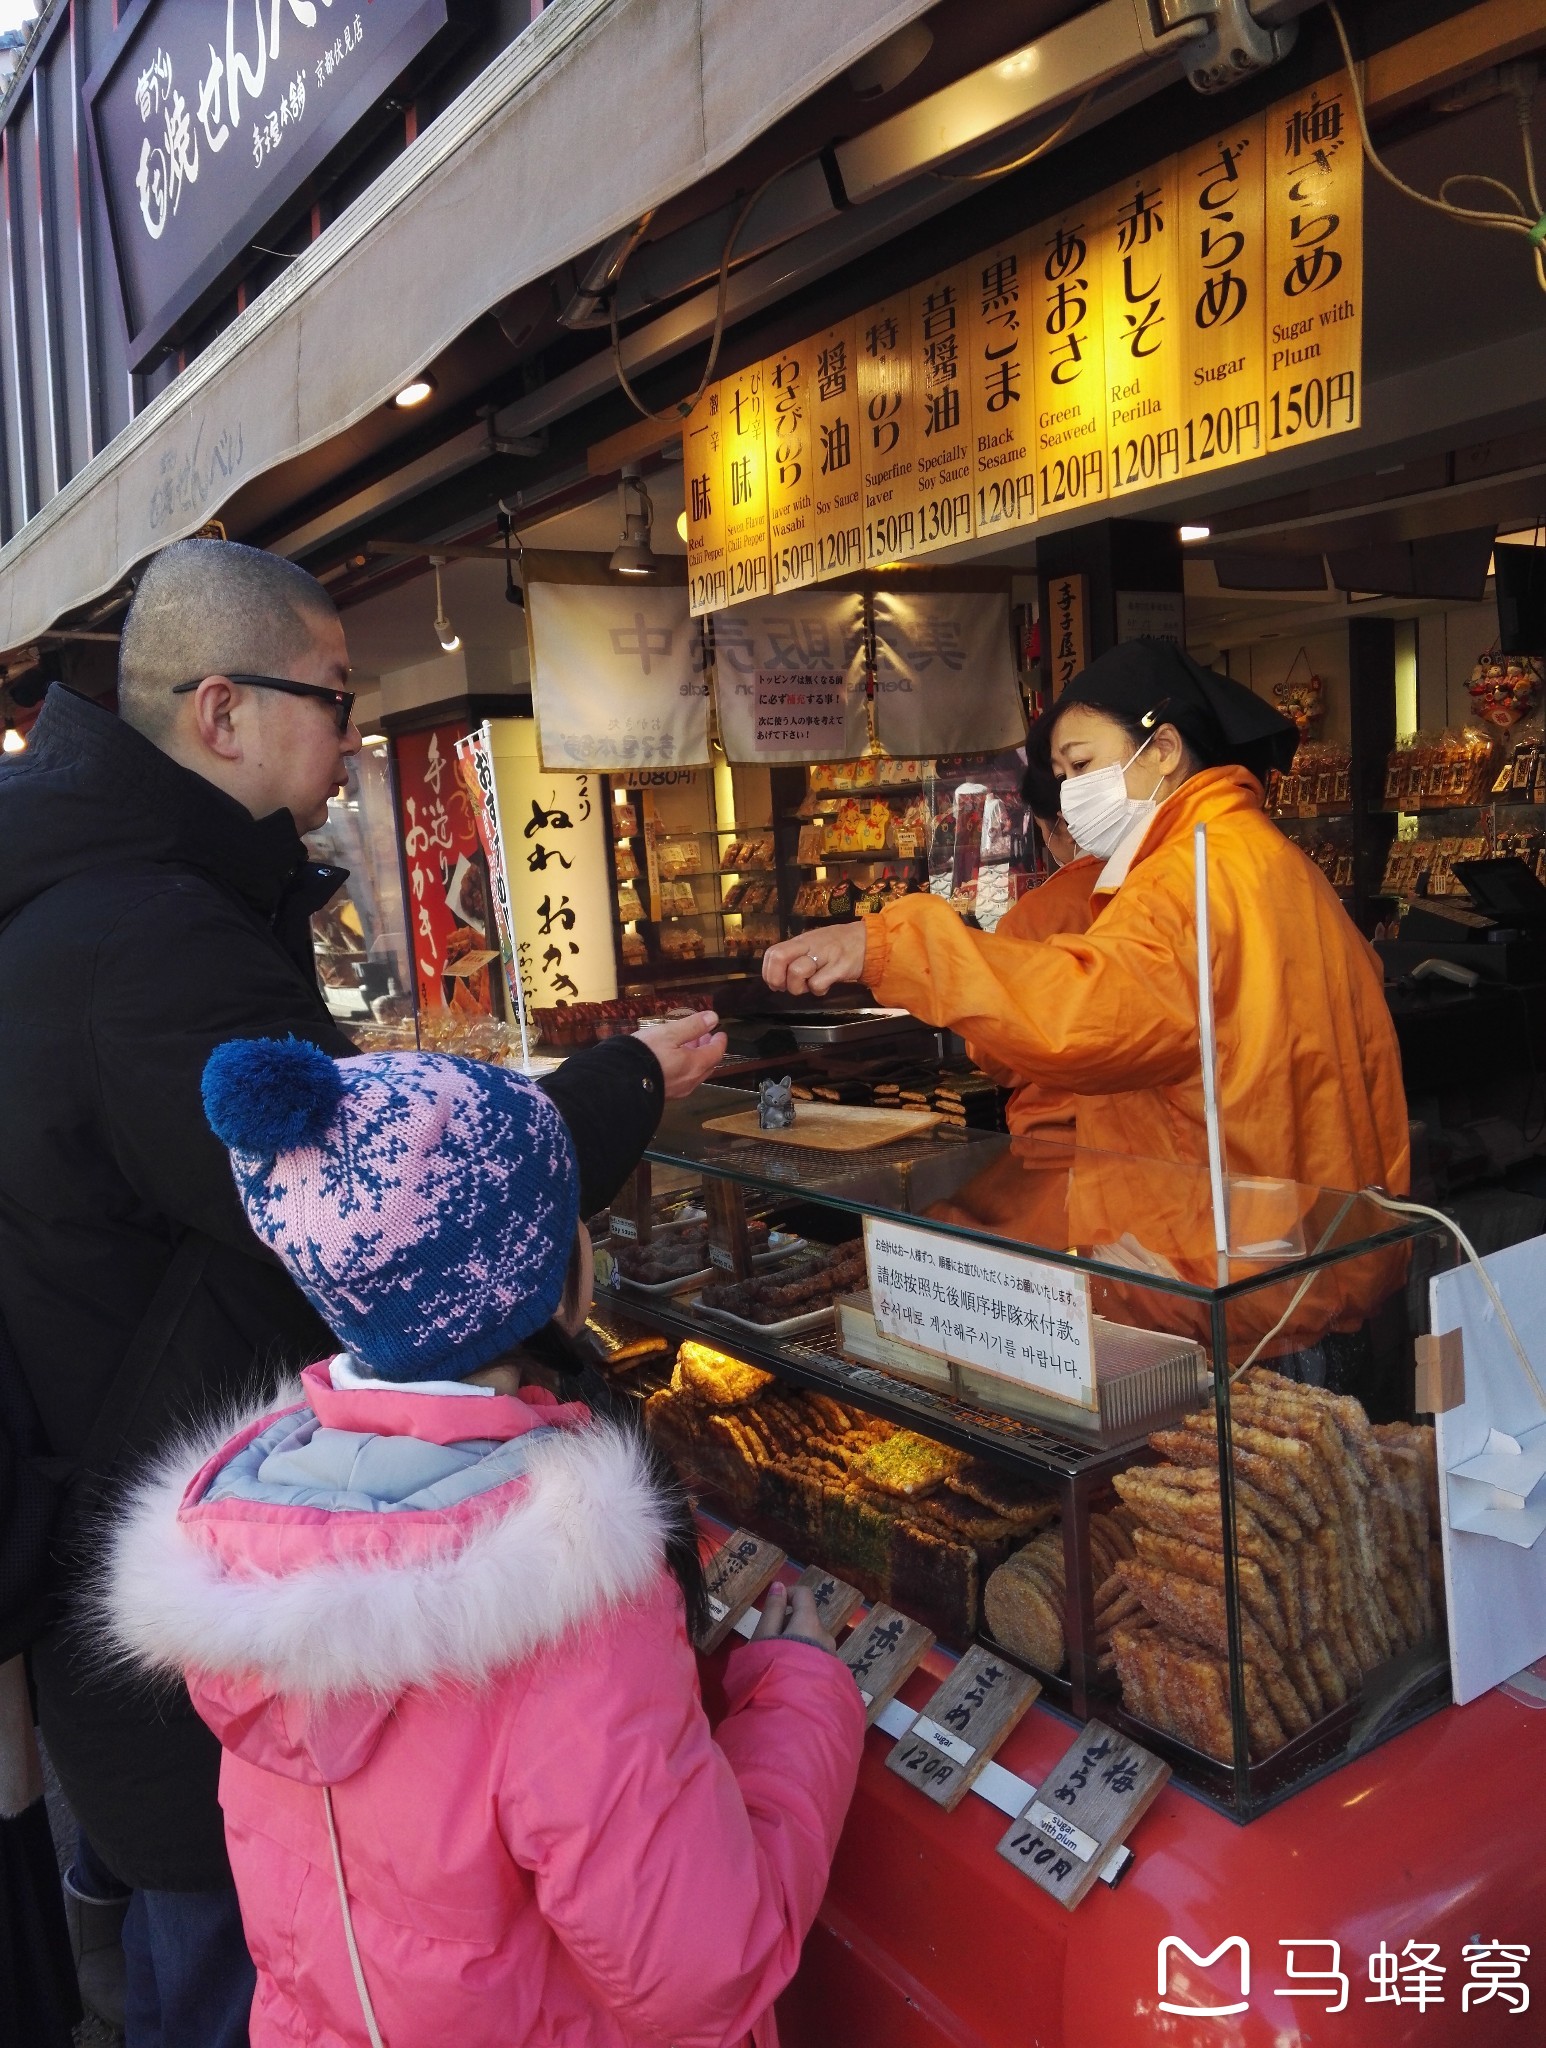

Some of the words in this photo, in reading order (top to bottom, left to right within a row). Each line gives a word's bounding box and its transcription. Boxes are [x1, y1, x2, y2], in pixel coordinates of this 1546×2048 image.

[315, 14, 363, 88] 京都伏見店
[1283, 93, 1344, 297] 梅ざらめ
[1194, 139, 1250, 329] ざらめ
[1116, 185, 1166, 358] 赤しそ
[1044, 222, 1089, 385] あおさ
[1272, 319, 1314, 344] Sugar
[1319, 300, 1355, 327] with
[981, 255, 1021, 412] 黒ごま
[922, 286, 960, 438] 昔醤油
[1194, 357, 1246, 387] Sugar
[1272, 341, 1321, 371] Plum
[866, 317, 902, 455] 特のり
[1110, 379, 1141, 403] Red
[1270, 370, 1355, 439] 150円
[771, 361, 802, 489] わさびのり
[817, 339, 851, 476] 醤油
[1039, 402, 1081, 428] Green
[1111, 398, 1161, 427] Perilla
[730, 388, 752, 507] 七味
[977, 426, 1015, 452] Black
[1039, 418, 1097, 450] Seaweed
[1184, 400, 1260, 466] 120円
[689, 425, 712, 522] 一味
[865, 460, 912, 487] Superfine
[917, 446, 968, 473] Specially
[918, 474, 937, 492] Soy
[938, 465, 970, 485] Sauce
[977, 444, 1027, 472] Sesame
[1040, 450, 1103, 507] 120円
[1112, 428, 1179, 489] 120円
[793, 496, 811, 512] with
[816, 497, 833, 515] Soy
[834, 490, 859, 509] Sauce
[866, 489, 893, 508] laver
[918, 493, 970, 544] 130円
[977, 471, 1035, 527] 120円
[689, 536, 705, 552] Red
[743, 532, 766, 548] Pepper
[773, 518, 805, 538] Wasabi
[866, 511, 914, 559] 150円
[704, 547, 724, 563] Pepper
[773, 542, 815, 586] 150円
[818, 526, 862, 573] 120円
[690, 570, 726, 610] 120円
[728, 555, 767, 597] 120円
[759, 674, 843, 685] トッピングは無くなる前
[756, 730, 810, 740] あげて下さい！
[758, 716, 844, 726] 次に使う人の事を考えて
[876, 1264, 1081, 1346] 請您按照先後順序排隊來付款。
[880, 1299, 926, 1326] 순서대로
[929, 1315, 1017, 1359] 계산해주시기를
[1021, 1345, 1082, 1380] 바랍니다.
[944, 1665, 1012, 1732] ざらめ
[933, 1731, 953, 1748] sugar
[900, 1744, 953, 1785] 120円
[1102, 1756, 1139, 1794] 梅
[1051, 1815, 1076, 1836] sugar
[1055, 1831, 1078, 1852] plum
[1010, 1832, 1073, 1882] 150円
